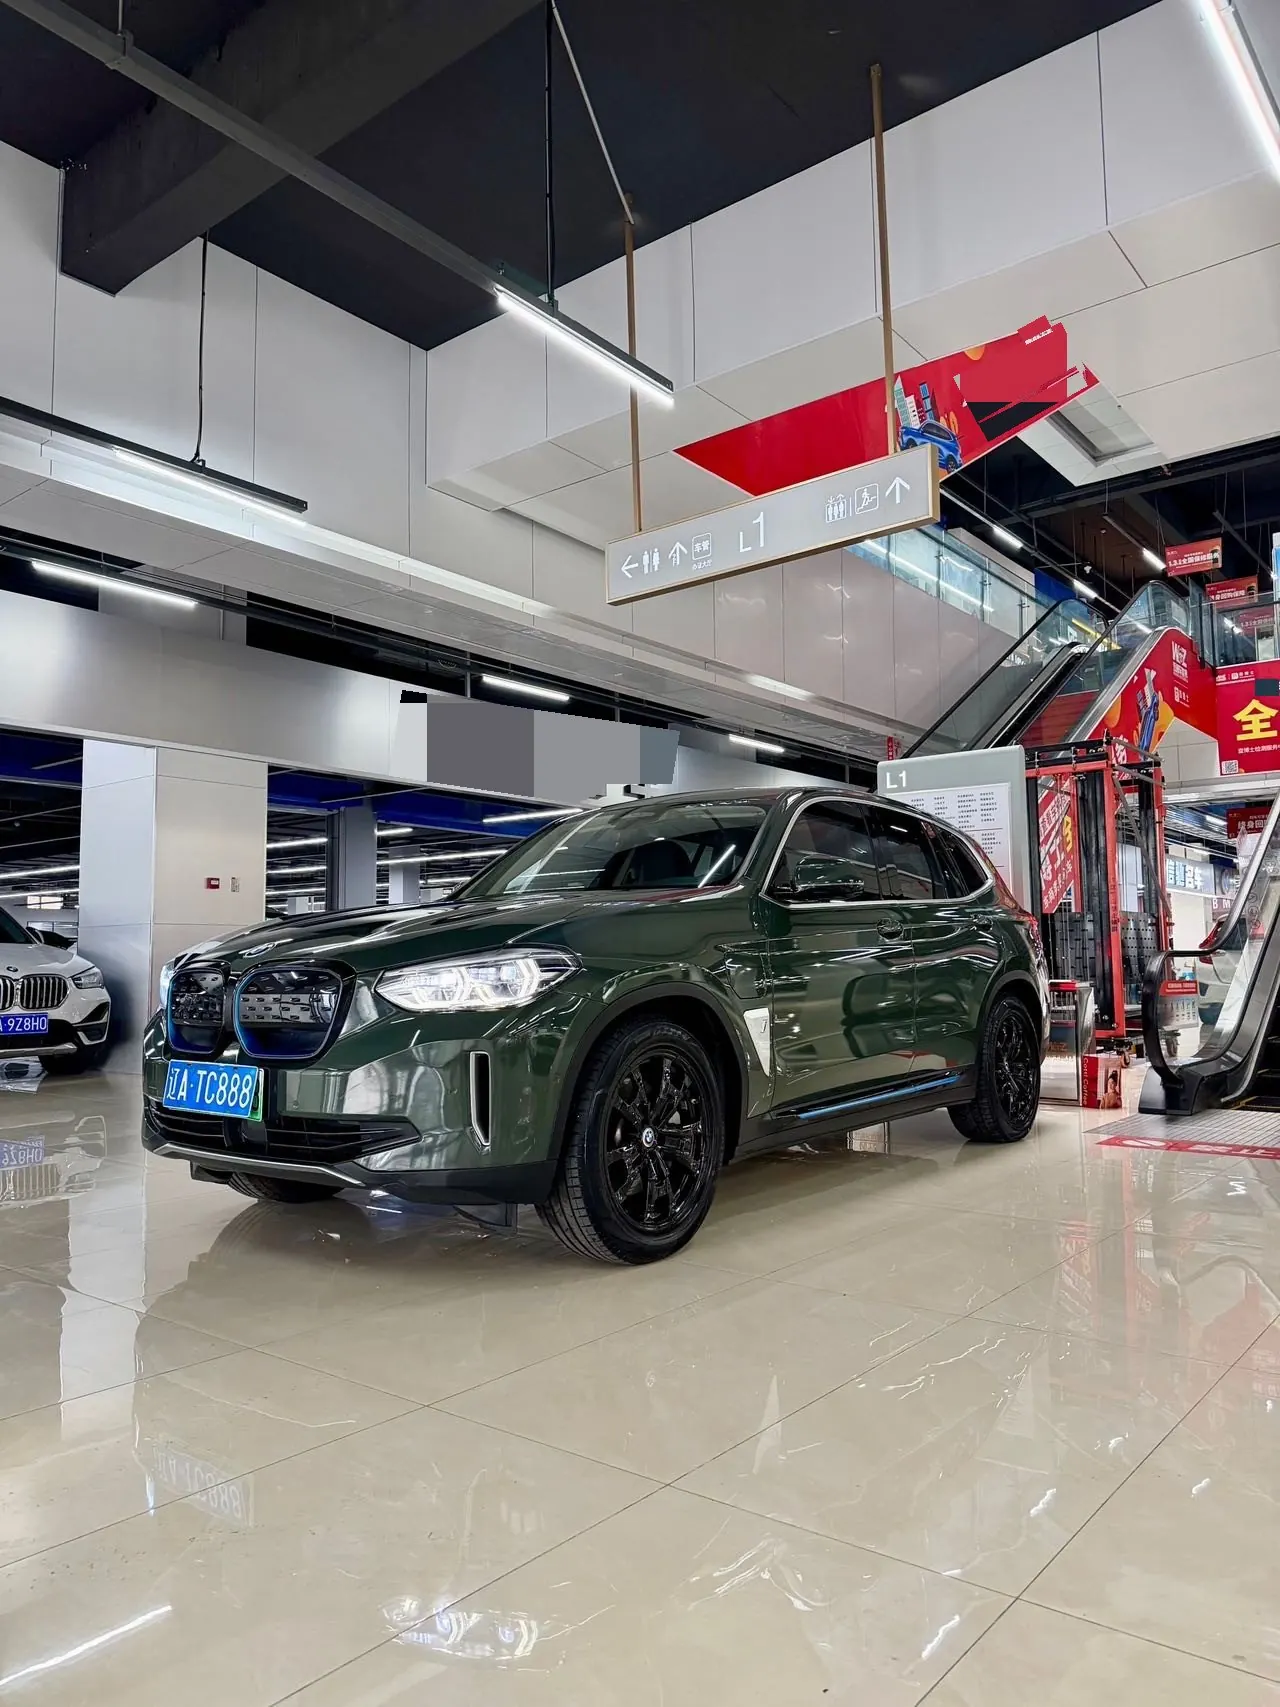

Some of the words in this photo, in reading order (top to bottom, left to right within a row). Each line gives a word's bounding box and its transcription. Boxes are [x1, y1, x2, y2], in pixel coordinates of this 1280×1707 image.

[694, 540, 710, 553] 车管
[739, 511, 765, 553] L1
[1233, 699, 1279, 741] 全
[886, 770, 907, 789] L1
